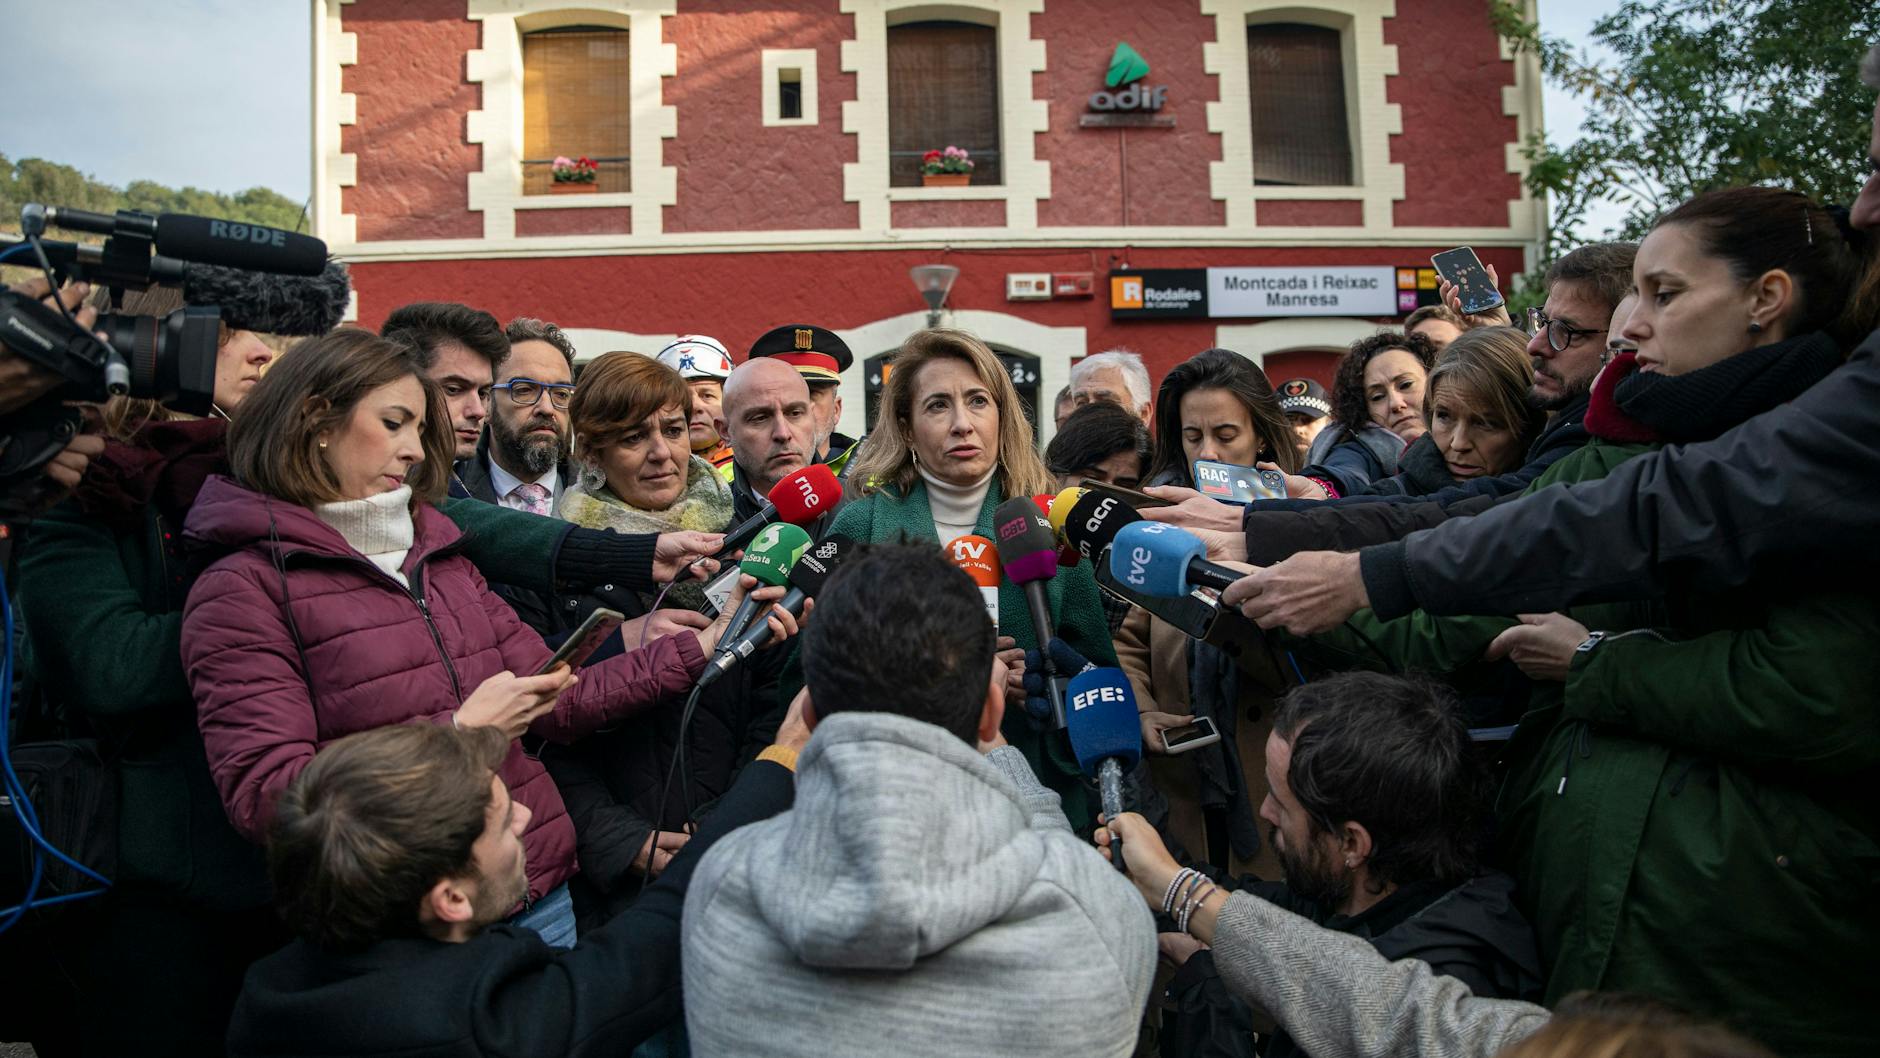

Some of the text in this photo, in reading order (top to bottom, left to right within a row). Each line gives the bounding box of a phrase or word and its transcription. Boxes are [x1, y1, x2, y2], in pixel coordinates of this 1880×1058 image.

[1088, 83, 1168, 110] adif
[210, 220, 286, 247] RØDE
[1224, 275, 1379, 291] Montcada i Reixac
[1144, 288, 1202, 301] Rodalies
[1266, 292, 1339, 307] Manresa
[1012, 368, 1024, 383] 2
[1200, 467, 1229, 483] RAC
[794, 475, 820, 509] rne
[1086, 497, 1119, 533] acn
[952, 539, 987, 561] tv
[1127, 546, 1152, 585] tve
